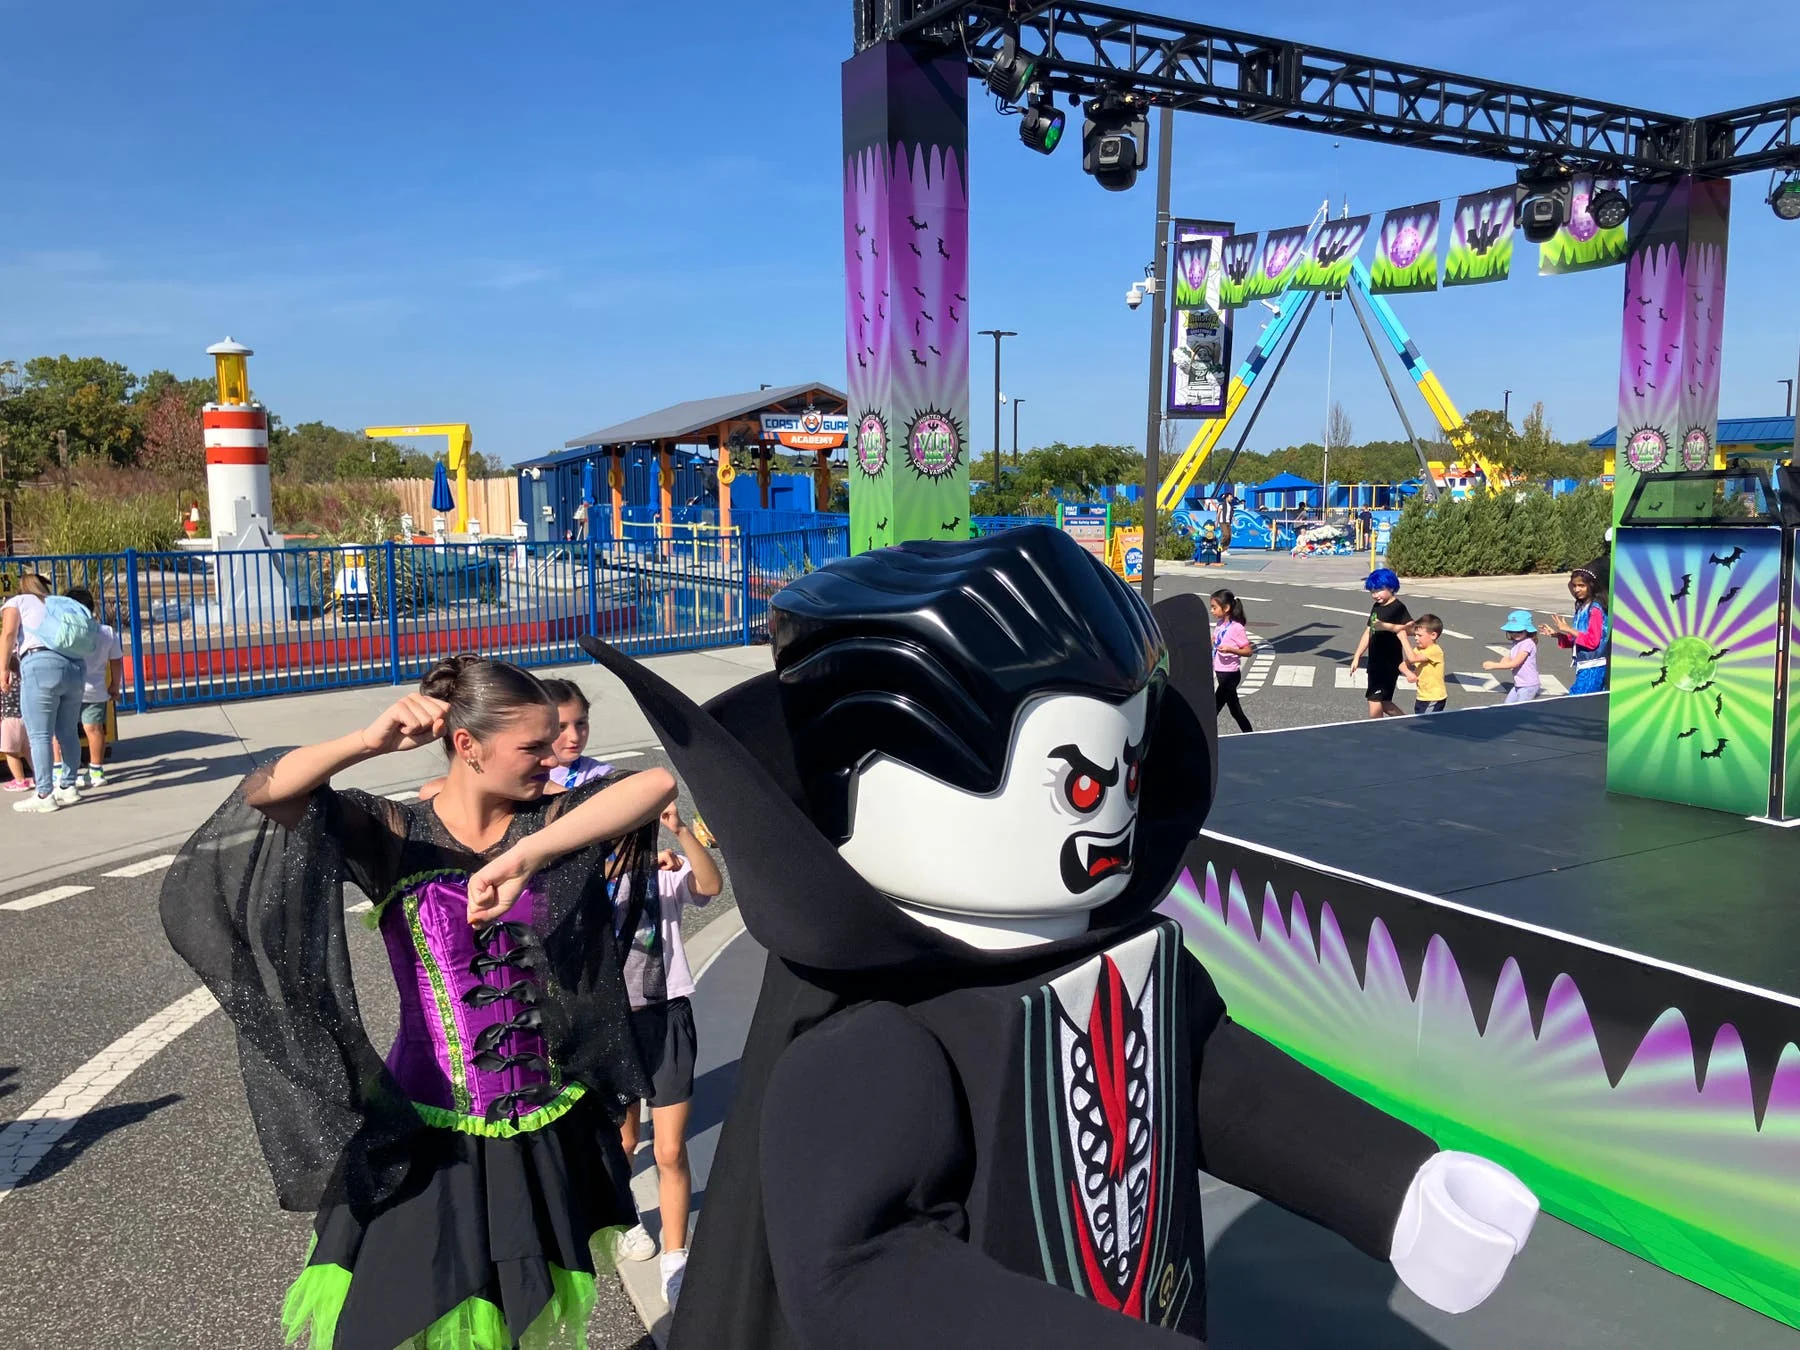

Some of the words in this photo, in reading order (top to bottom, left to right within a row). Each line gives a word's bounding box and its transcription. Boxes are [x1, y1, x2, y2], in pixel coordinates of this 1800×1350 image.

[919, 414, 941, 423] HOSTED
[765, 418, 800, 429] COAST
[823, 421, 848, 430] GUAR
[790, 435, 834, 444] ACADEMY
[913, 457, 929, 473] LORD
[929, 457, 955, 475] VAMPYRE
